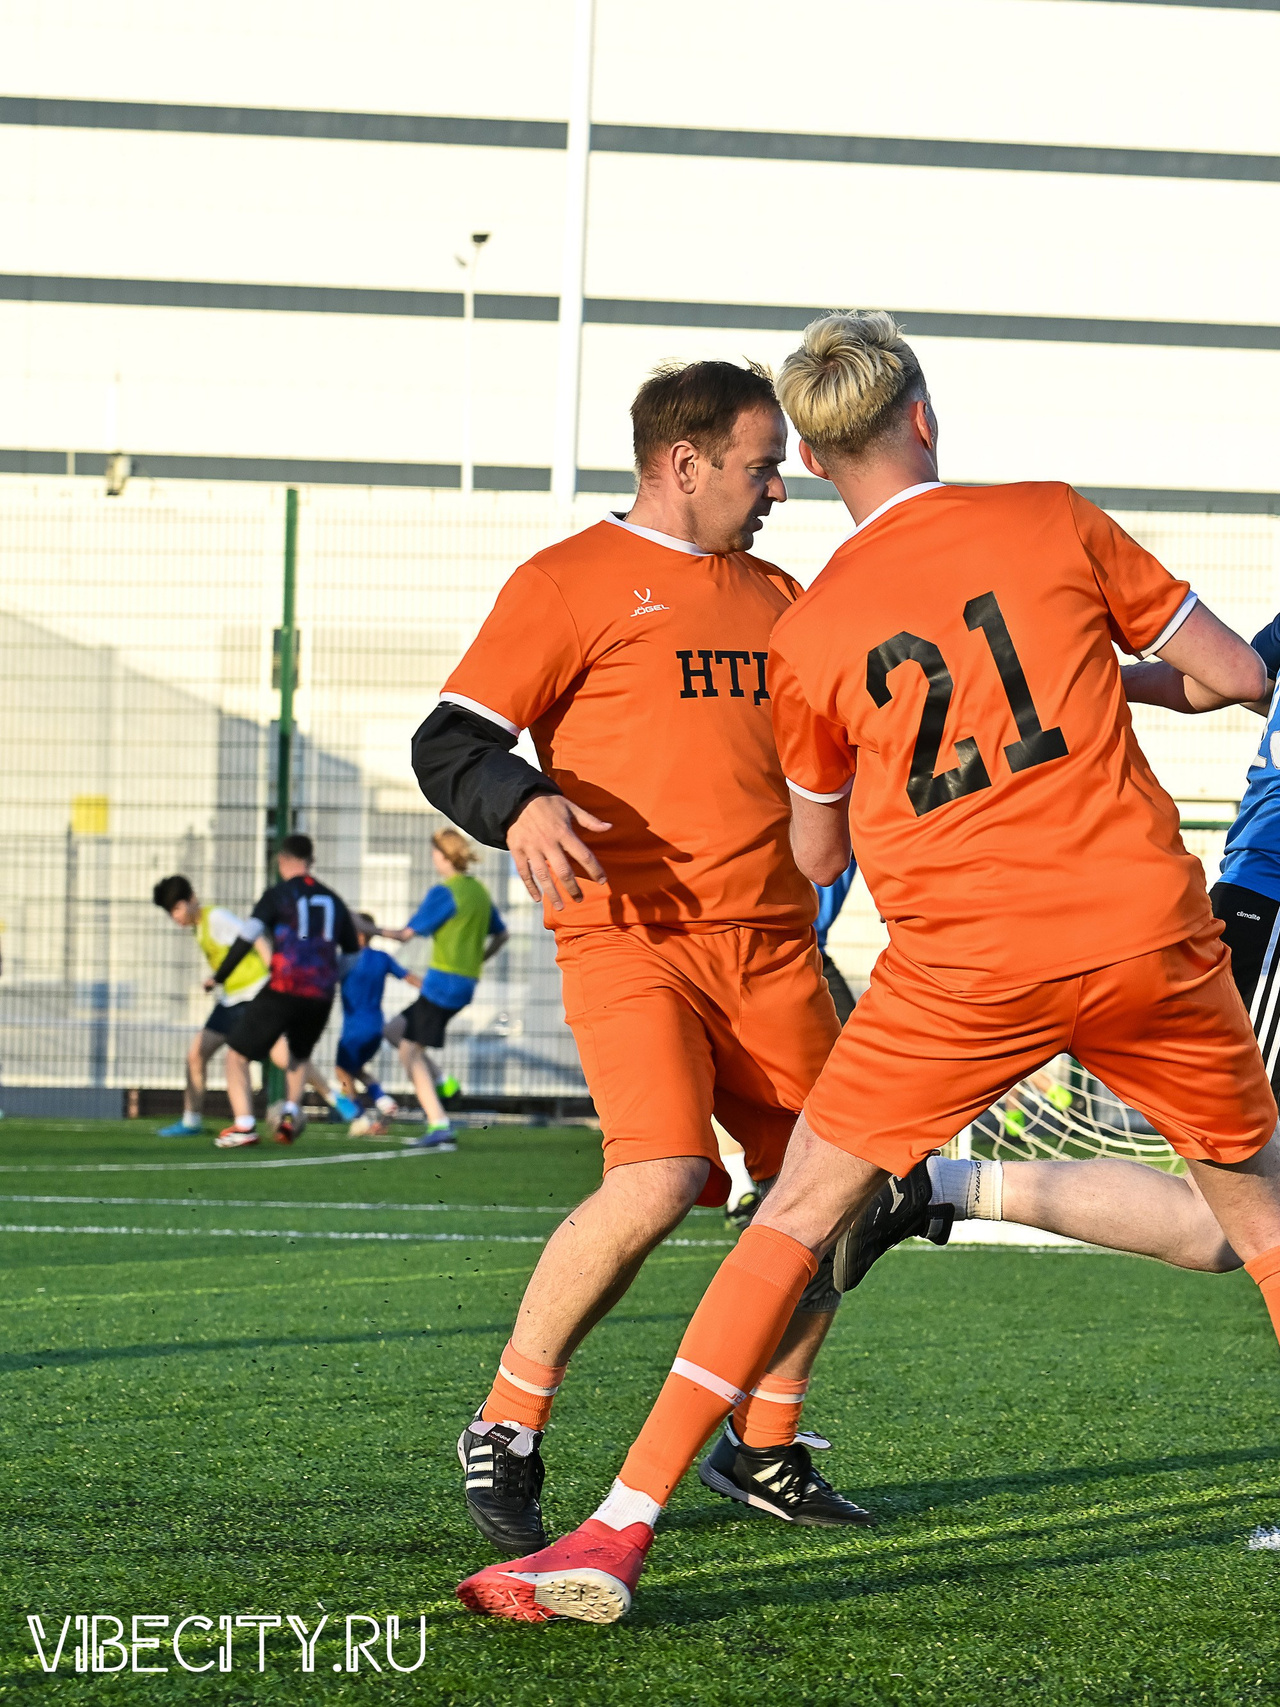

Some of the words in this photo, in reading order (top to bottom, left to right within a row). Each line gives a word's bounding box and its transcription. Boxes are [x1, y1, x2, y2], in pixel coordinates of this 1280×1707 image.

[630, 604, 670, 617] JÖGEL
[866, 591, 1069, 817] 21
[297, 894, 335, 942] 17
